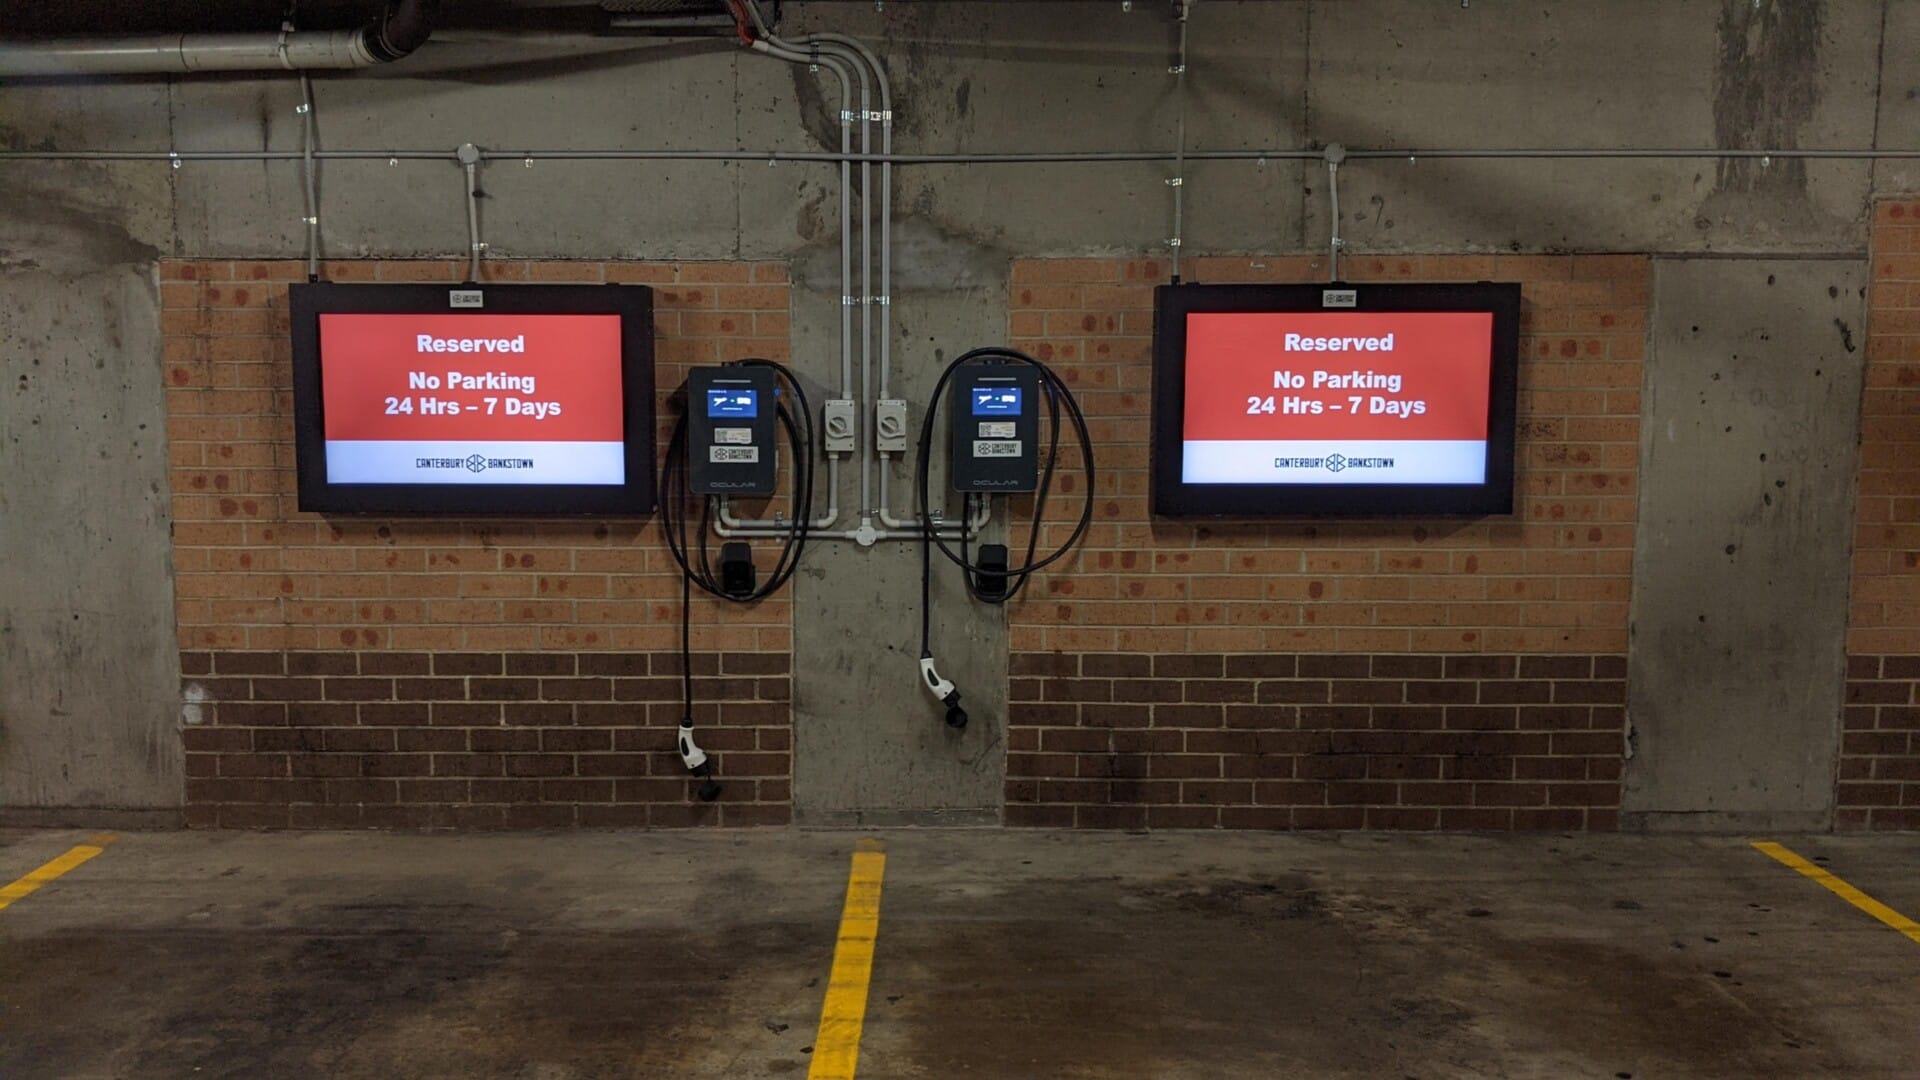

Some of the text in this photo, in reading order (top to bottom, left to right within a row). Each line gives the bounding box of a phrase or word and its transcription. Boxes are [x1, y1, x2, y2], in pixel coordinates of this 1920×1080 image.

[416, 334, 525, 353] Reserved
[1284, 333, 1394, 352] Reserved
[409, 371, 536, 395] No Parking
[1273, 370, 1402, 393] No Parking
[384, 396, 414, 415] 24
[420, 397, 461, 415] Hrs
[483, 397, 498, 415] 7
[505, 397, 562, 420] Days
[1246, 396, 1276, 415] 24
[1282, 396, 1324, 415] Hrs
[1347, 396, 1363, 415] 7
[1369, 396, 1426, 419] Days
[416, 458, 534, 469] CANTERBURY BANKSTOWN
[1275, 458, 1394, 468] CANTERBURY BANKSTOWN
